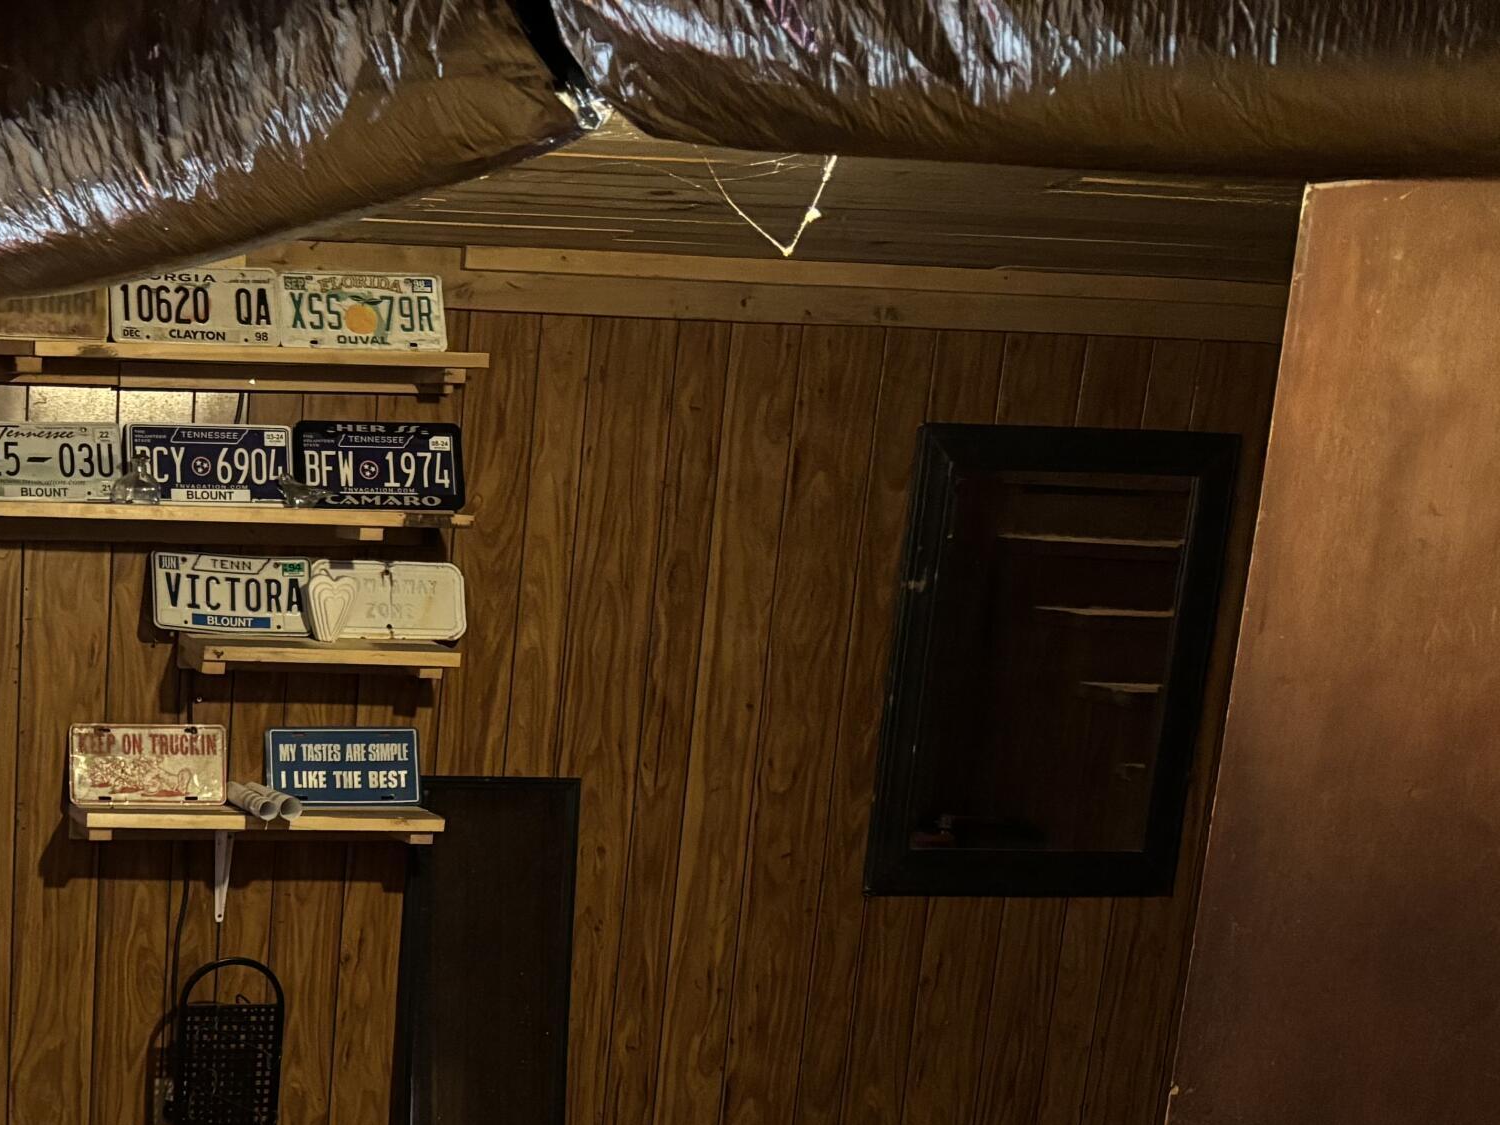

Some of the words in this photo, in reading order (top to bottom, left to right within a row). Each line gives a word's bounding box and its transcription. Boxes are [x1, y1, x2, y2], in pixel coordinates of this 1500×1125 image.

[150, 272, 217, 284] RGIA
[317, 275, 404, 294] FLORIDA
[120, 283, 210, 325] 10620
[235, 287, 272, 326] QA
[289, 291, 343, 331] XSS
[380, 295, 435, 332] 79R
[123, 328, 141, 338] DEC
[168, 328, 227, 341] CLAYTON
[254, 331, 269, 342] 98
[336, 334, 392, 346] DUVAL
[99, 430, 109, 439] 22
[180, 430, 240, 440] TENNESSEE
[336, 424, 387, 433] HER
[347, 435, 405, 444] TENNESSEE
[58, 442, 115, 478] 03U
[216, 446, 283, 486] 6904
[304, 450, 354, 488] BFW
[383, 450, 451, 489] 1974
[20, 487, 69, 498] BLOUNT
[186, 490, 235, 500] BLOUNT
[323, 494, 443, 507] CAMARO
[162, 555, 177, 569] JUN
[211, 558, 252, 571] TENN
[165, 571, 303, 613] VICTORA
[206, 615, 254, 628] BLOUNT
[121, 733, 143, 755] ON
[149, 732, 218, 757] TRUCKIN
[278, 743, 297, 762] MY
[300, 743, 341, 762] TASTES
[345, 743, 367, 762] ARE
[368, 742, 409, 762] SIMPLE
[280, 770, 287, 789] I
[293, 770, 327, 789] LIKE
[333, 770, 362, 789] THE
[367, 769, 408, 789] BEST
